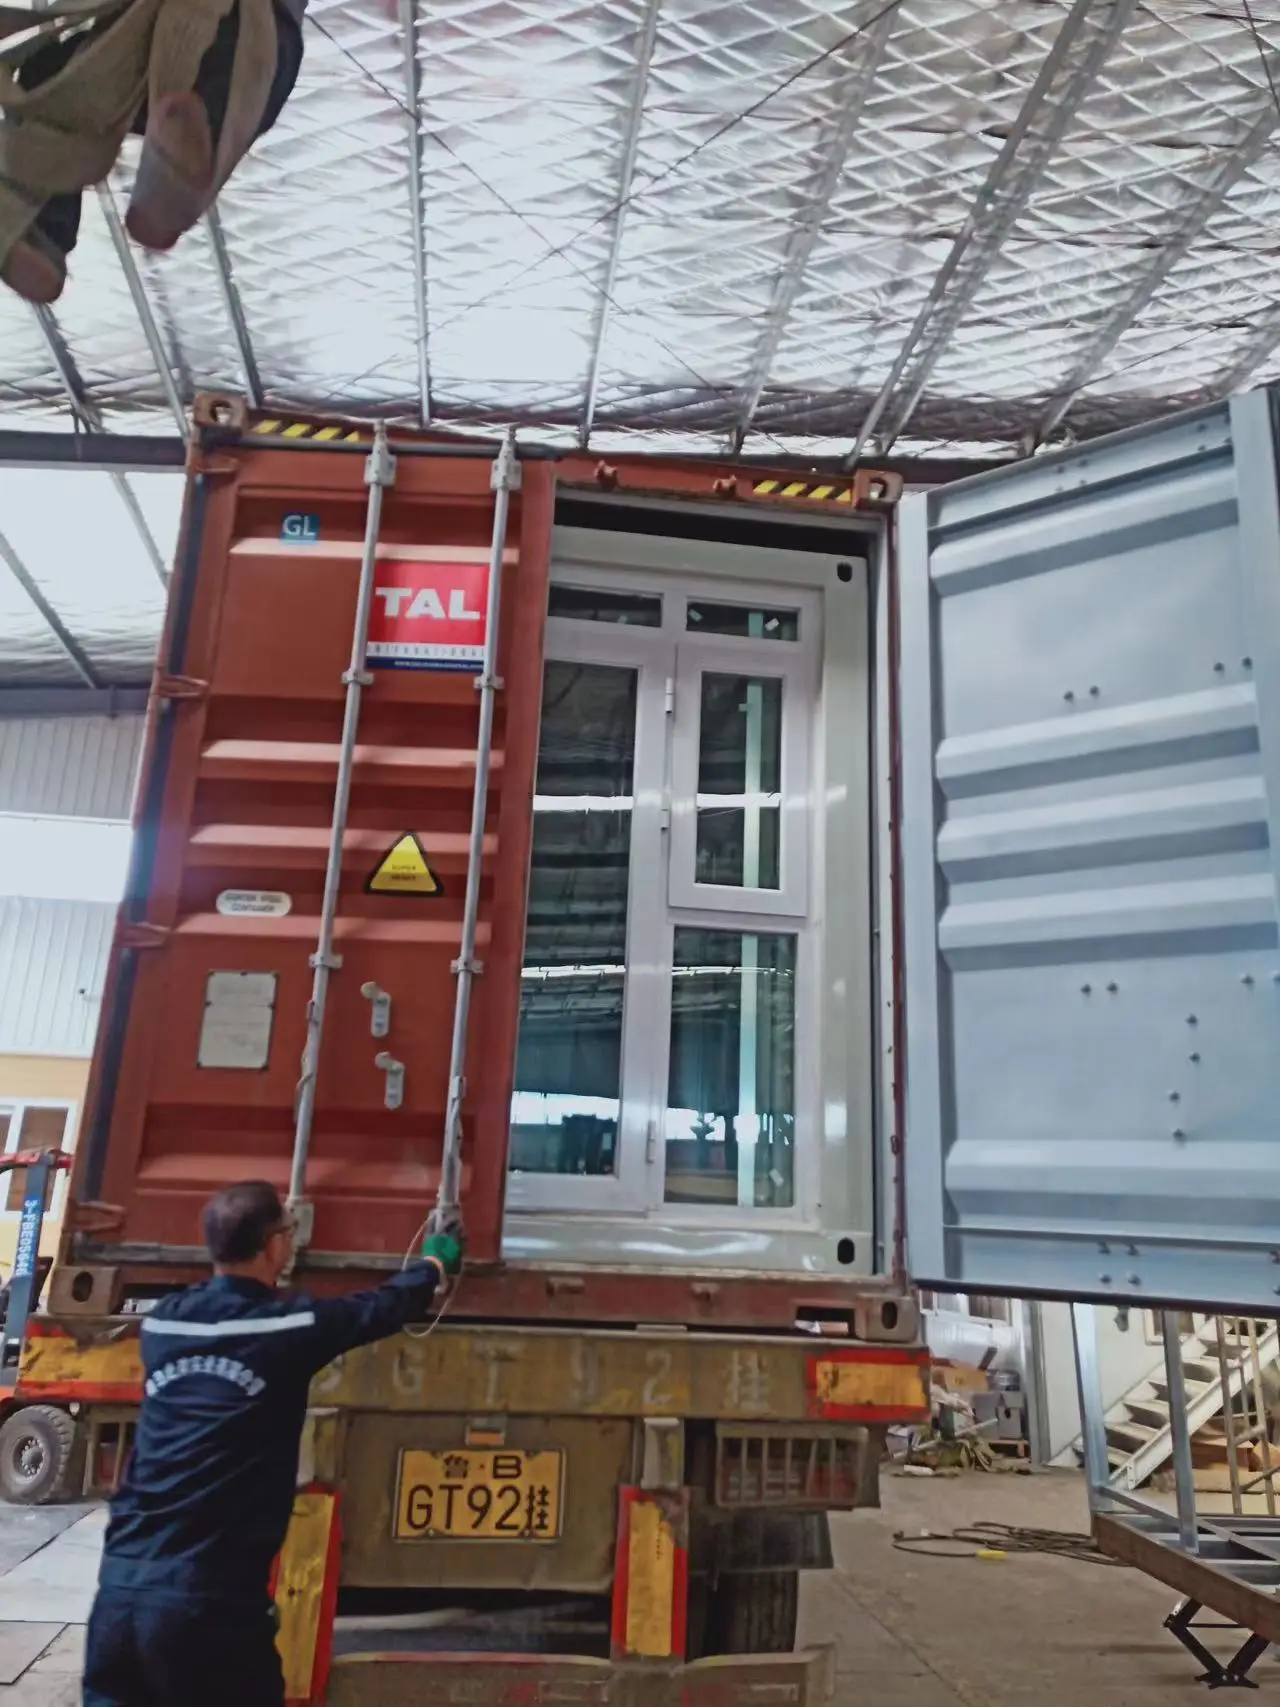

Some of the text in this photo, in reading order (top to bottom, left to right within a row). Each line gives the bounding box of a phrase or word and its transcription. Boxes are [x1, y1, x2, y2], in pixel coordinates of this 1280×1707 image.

[282, 514, 318, 537] GL
[375, 586, 481, 620] TAL
[406, 1484, 550, 1530] GT92挂
